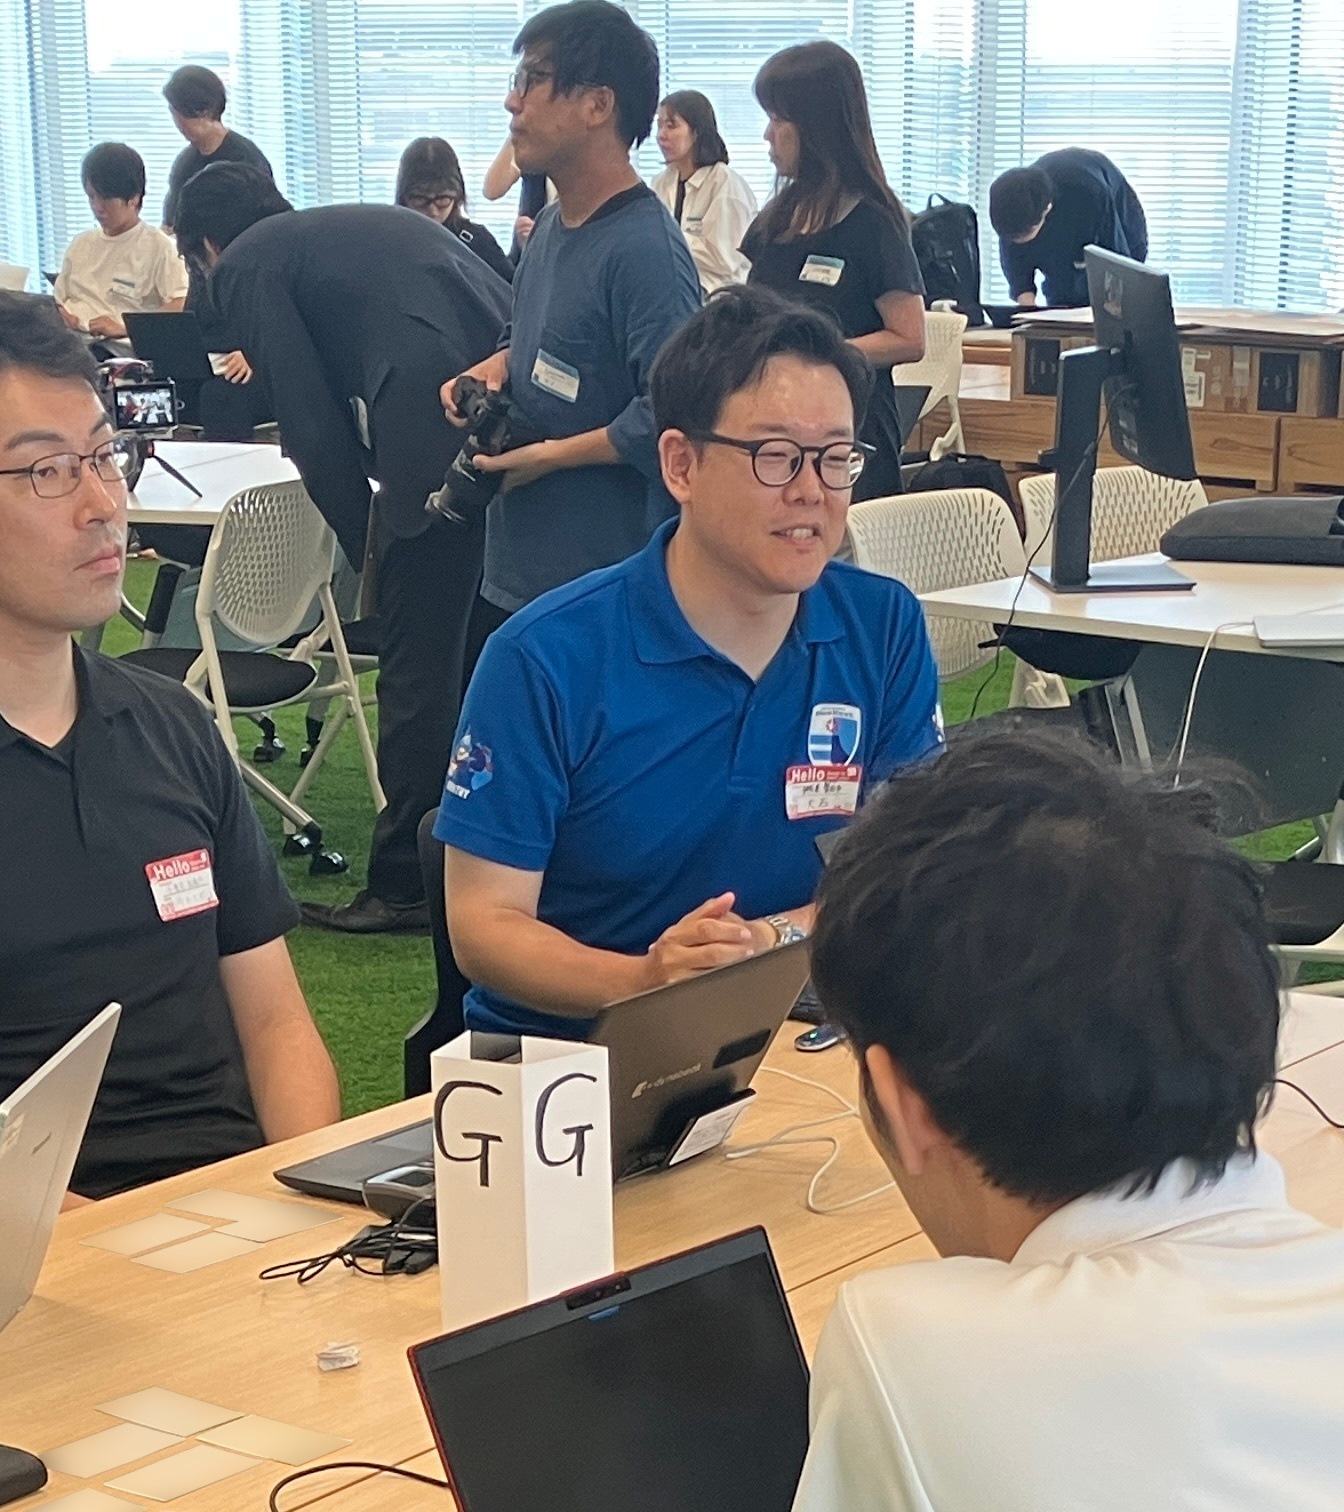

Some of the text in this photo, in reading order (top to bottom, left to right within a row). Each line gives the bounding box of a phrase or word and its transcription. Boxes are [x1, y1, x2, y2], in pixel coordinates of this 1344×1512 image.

[791, 768, 825, 783] Hello
[153, 860, 190, 880] Hello
[434, 1080, 503, 1188] G
[535, 1072, 597, 1177] G
